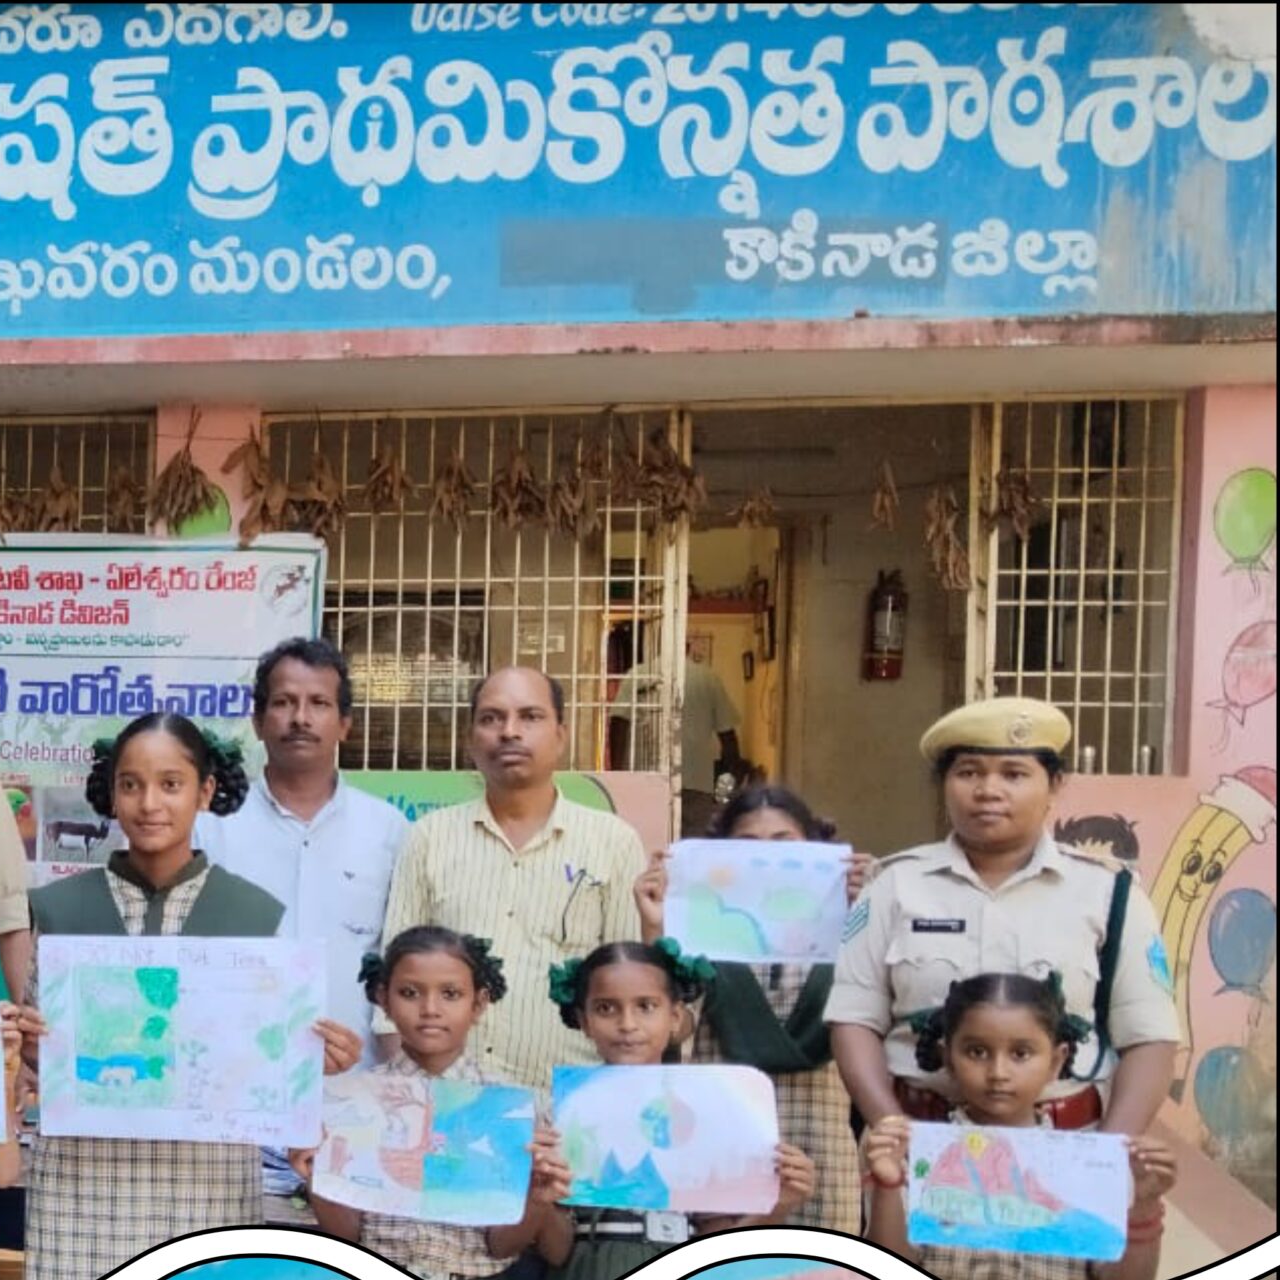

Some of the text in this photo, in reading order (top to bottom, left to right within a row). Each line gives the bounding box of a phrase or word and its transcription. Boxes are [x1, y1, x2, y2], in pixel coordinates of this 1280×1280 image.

[189, 234, 451, 299] మండలం,
[723, 208, 938, 283] కాకినాడ
[952, 219, 1097, 298] జిల్లా
